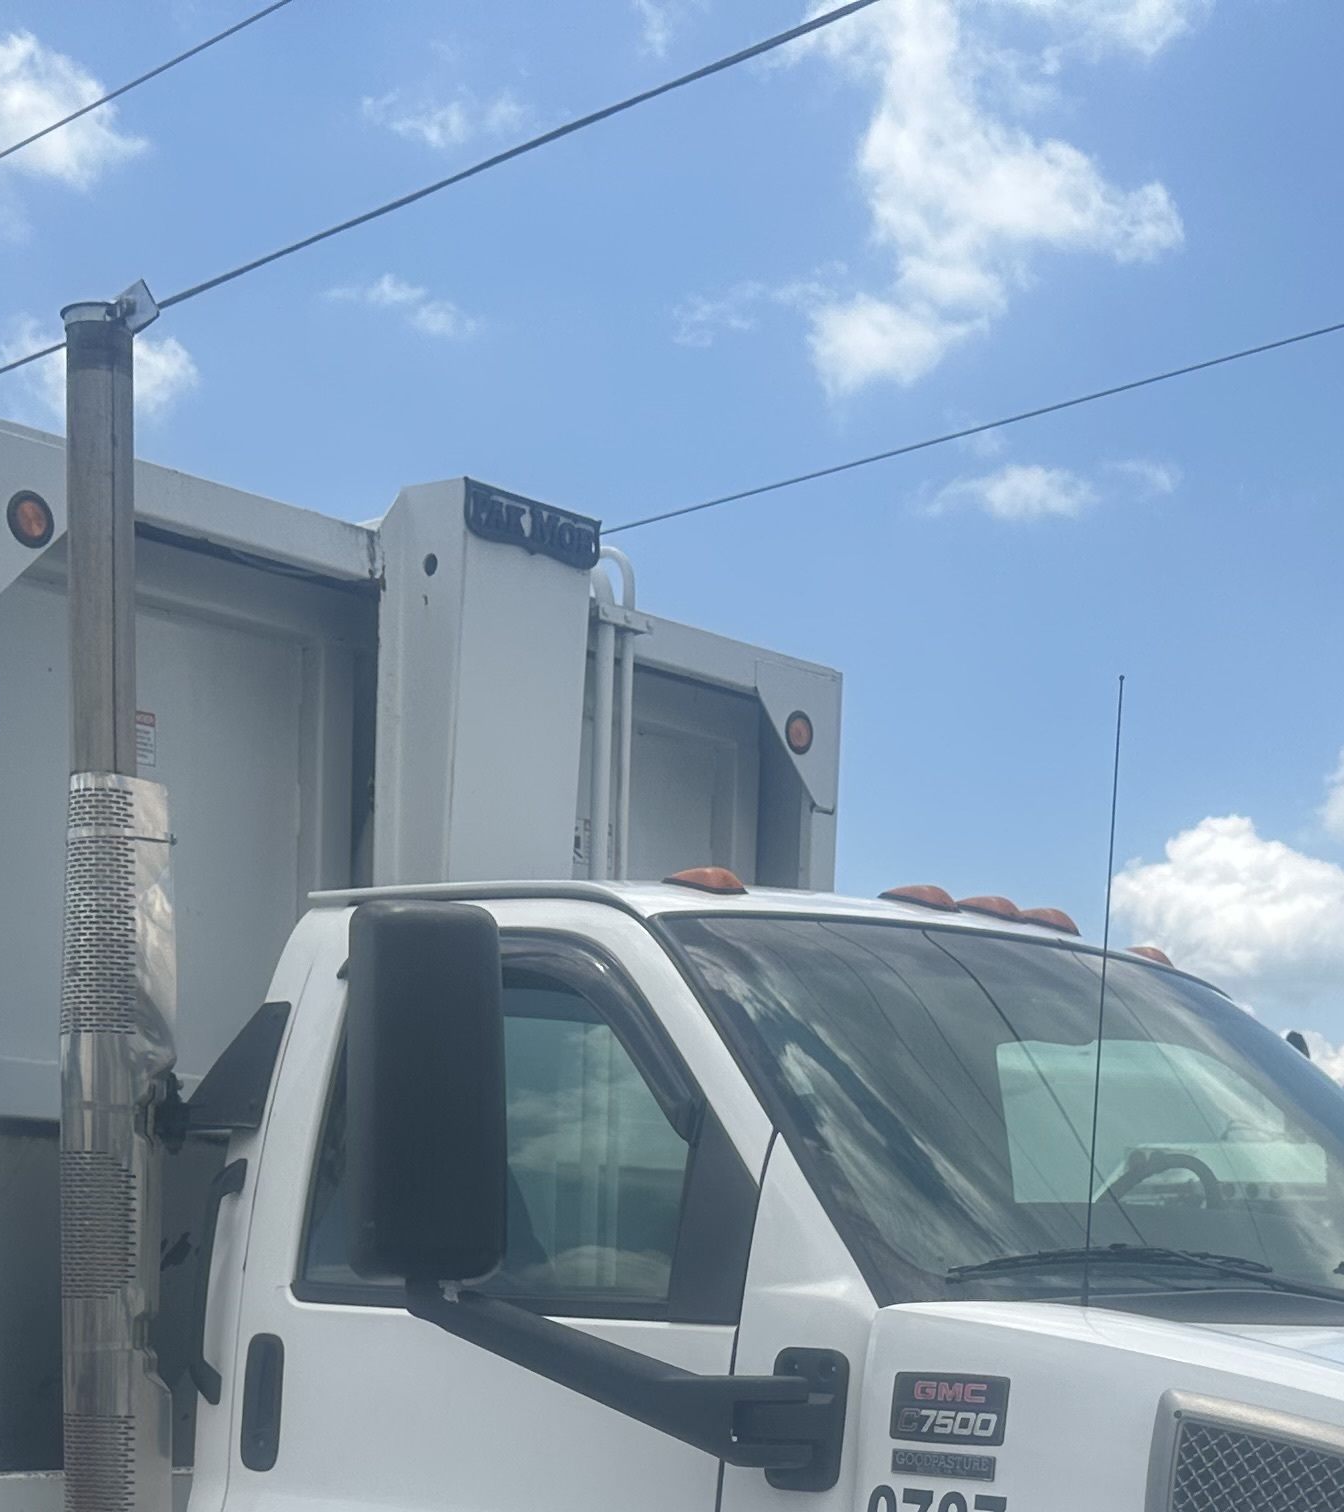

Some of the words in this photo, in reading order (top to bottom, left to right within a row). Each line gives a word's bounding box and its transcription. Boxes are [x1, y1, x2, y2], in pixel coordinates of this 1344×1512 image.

[913, 1380, 988, 1404] GMC
[897, 1407, 998, 1437] C7500
[895, 1451, 990, 1473] GOODPASTURE
